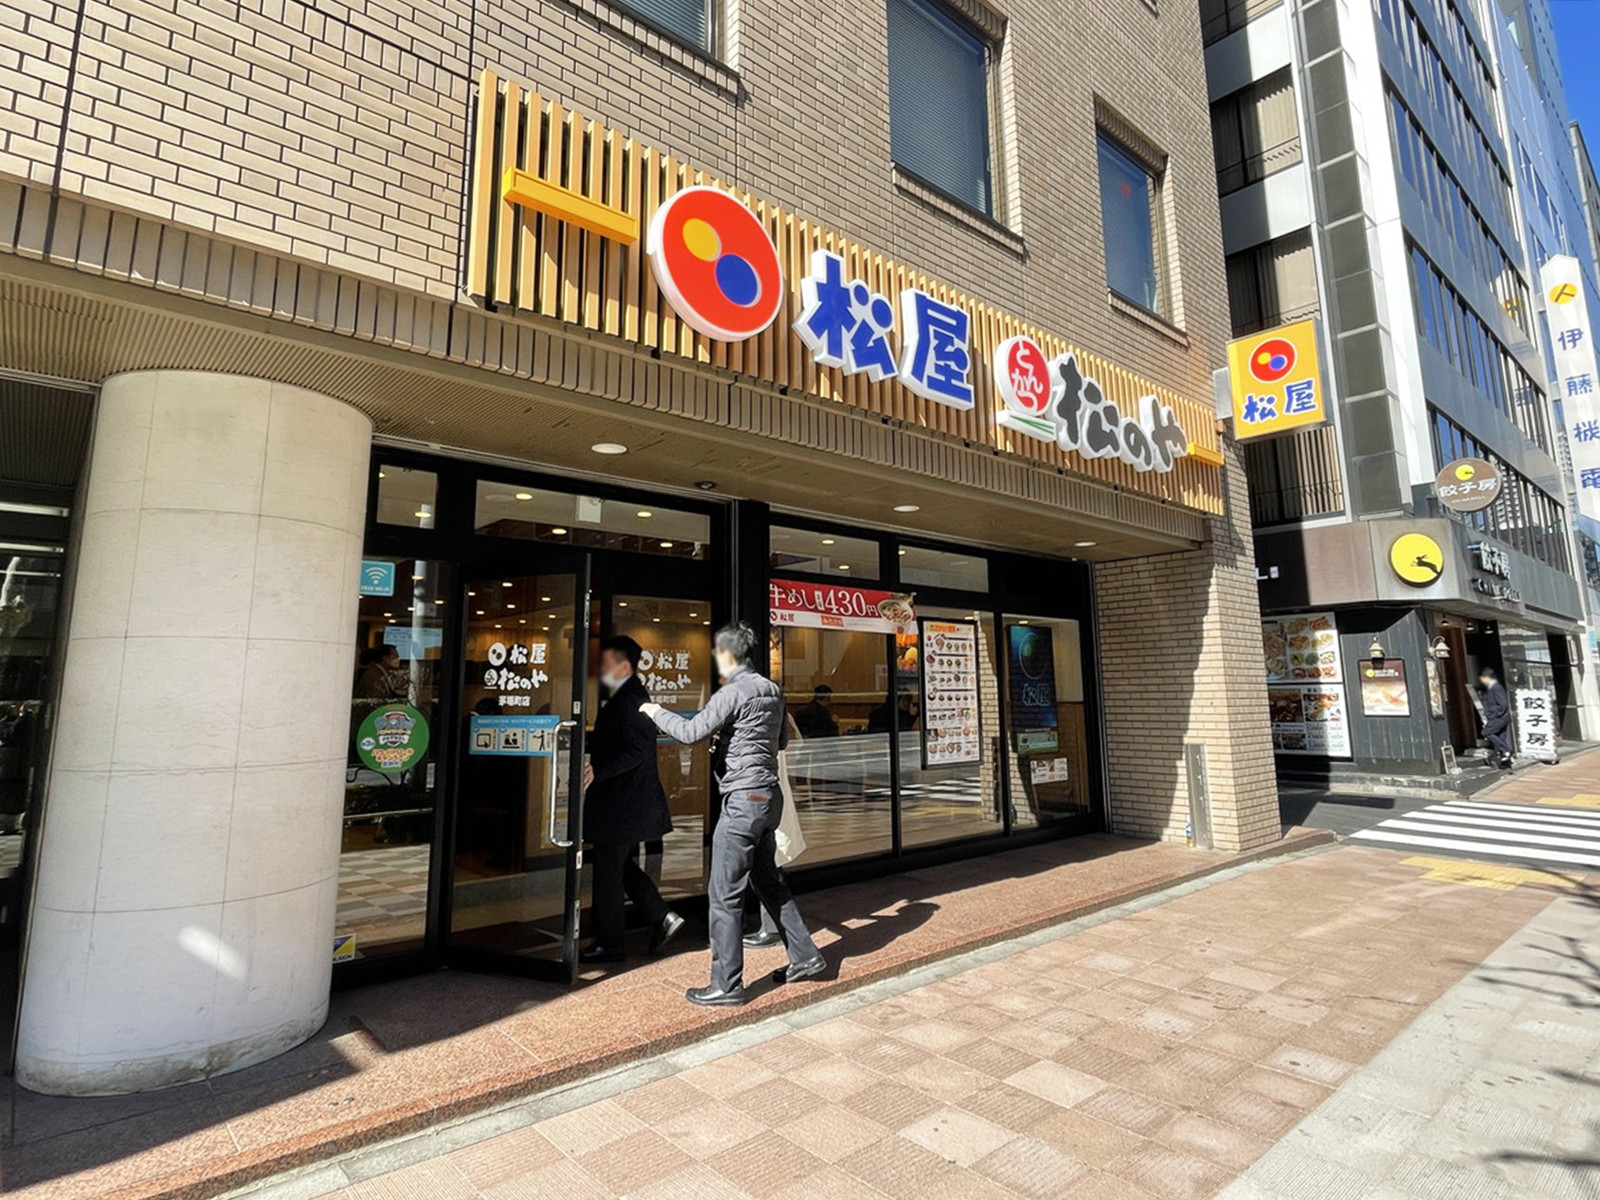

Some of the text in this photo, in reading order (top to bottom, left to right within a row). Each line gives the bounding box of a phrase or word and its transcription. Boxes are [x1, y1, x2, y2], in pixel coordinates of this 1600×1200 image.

[796, 250, 974, 410] 松屋
[1056, 354, 1189, 470] 松のや
[1242, 379, 1317, 423] 松屋
[1438, 477, 1498, 498] 餃子房
[824, 589, 879, 616] 430円
[510, 643, 547, 664] 松屋
[656, 652, 690, 670] 松屋
[498, 667, 549, 691] 松のや
[646, 672, 692, 691] 松のや
[1522, 696, 1550, 747] 餃子房
